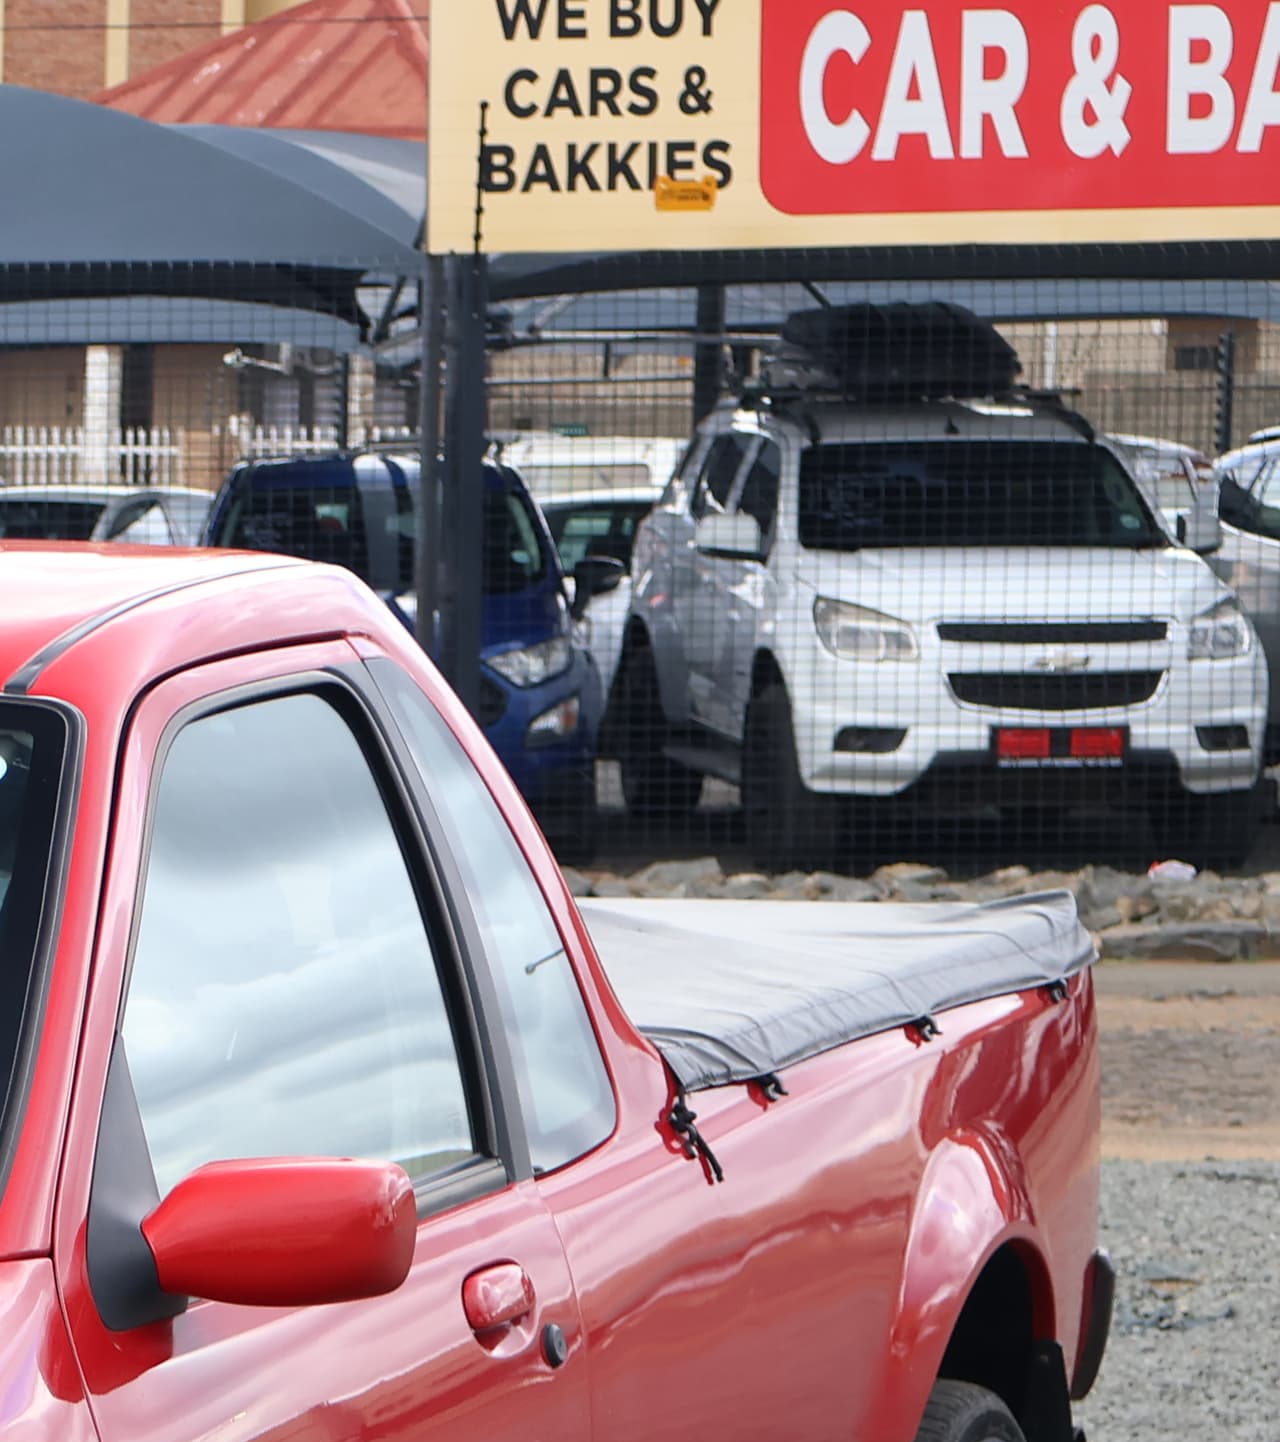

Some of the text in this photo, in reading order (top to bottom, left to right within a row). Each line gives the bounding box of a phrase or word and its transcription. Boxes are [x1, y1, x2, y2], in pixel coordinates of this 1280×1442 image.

[496, 0, 721, 40] WE BUY
[505, 65, 713, 118] CARS &
[799, 9, 1030, 164] CAR
[1060, 4, 1133, 159] &
[481, 140, 733, 192] BAKKIES
